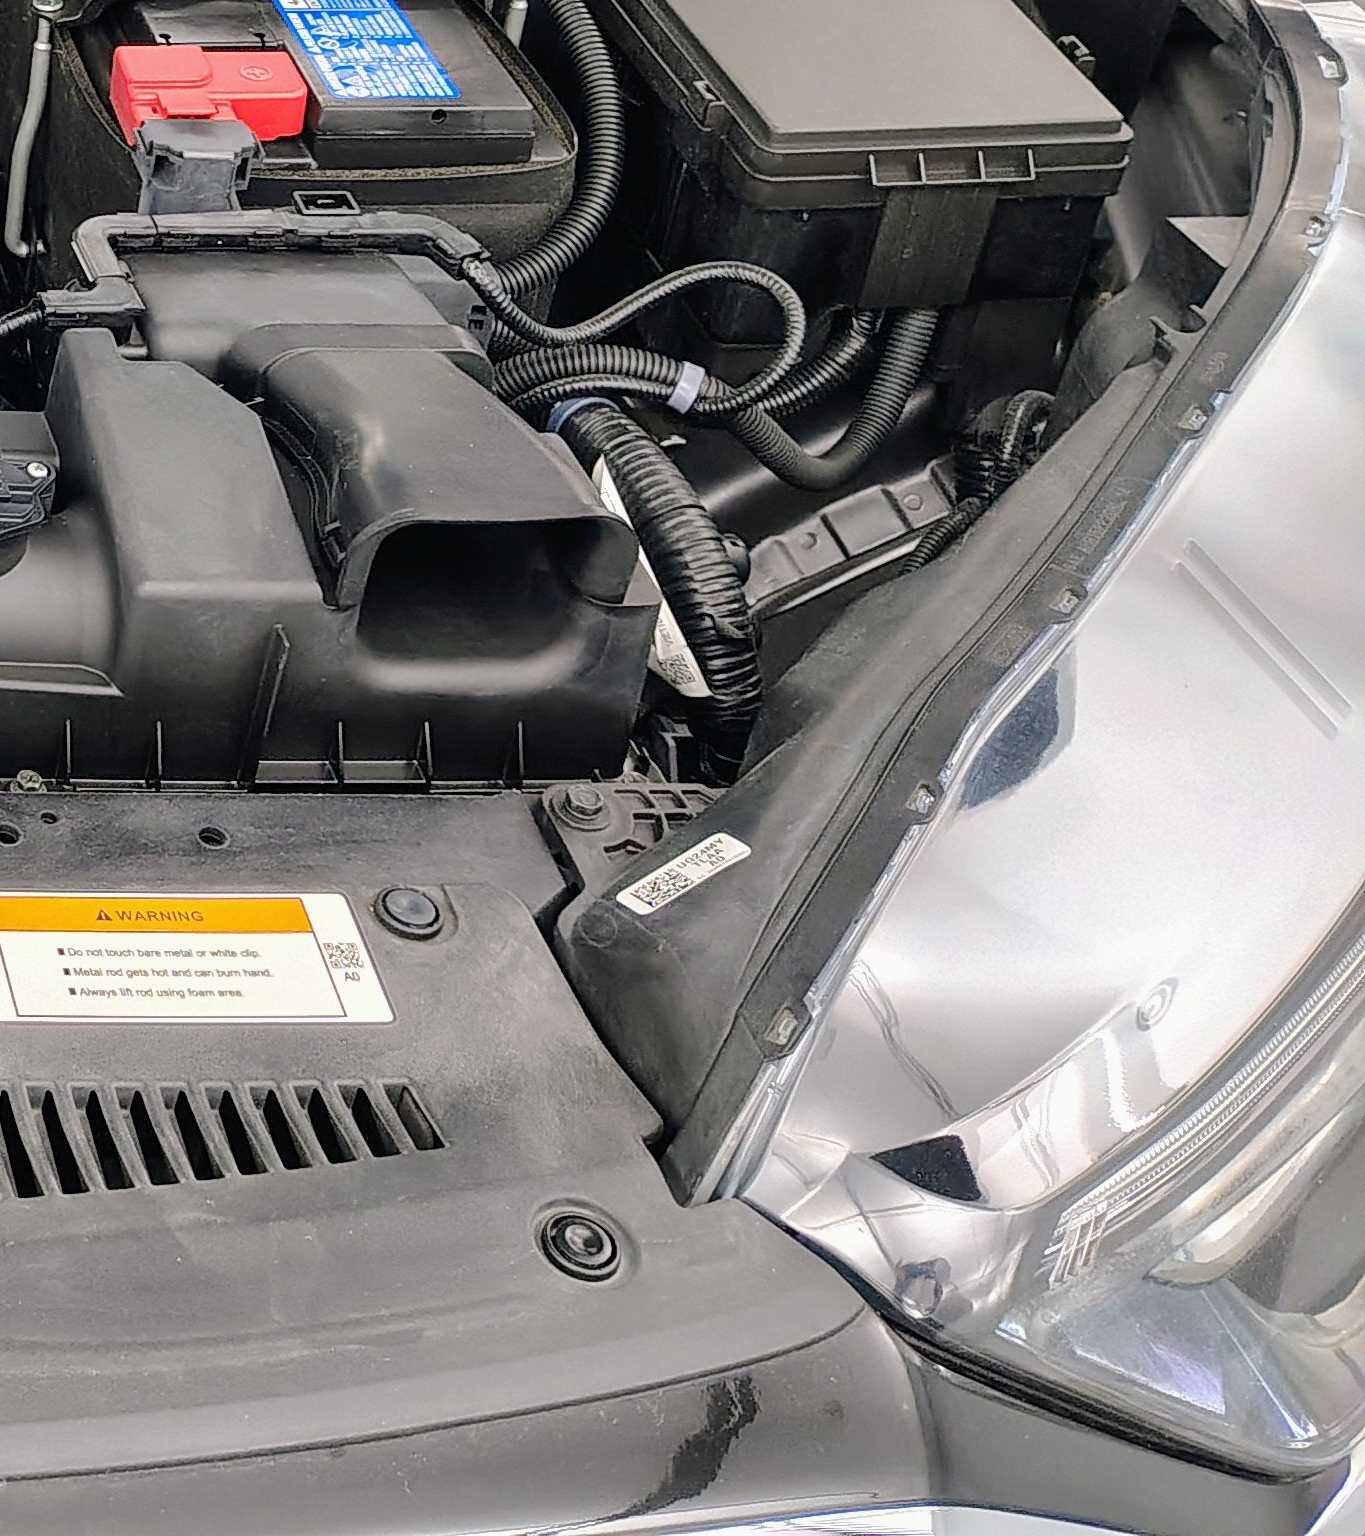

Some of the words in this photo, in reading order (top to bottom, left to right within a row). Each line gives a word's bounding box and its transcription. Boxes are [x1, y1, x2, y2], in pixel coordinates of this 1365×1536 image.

[115, 910, 204, 922] WARNING
[67, 947, 83, 957] Do
[86, 949, 103, 957] not
[105, 948, 135, 957] touch
[137, 949, 162, 957] bare
[164, 949, 193, 958] metal
[209, 949, 238, 958] white
[73, 967, 103, 977] Metal
[106, 968, 123, 977] rod
[126, 968, 149, 979] gets
[151, 968, 169, 977] hot
[172, 969, 192, 977] and
[243, 968, 274, 978] hand.
[80, 987, 118, 999] Always
[119, 987, 134, 997] lift
[136, 988, 154, 997] rod
[156, 989, 186, 999] using
[187, 988, 216, 997] foam
[218, 989, 245, 997] area.
